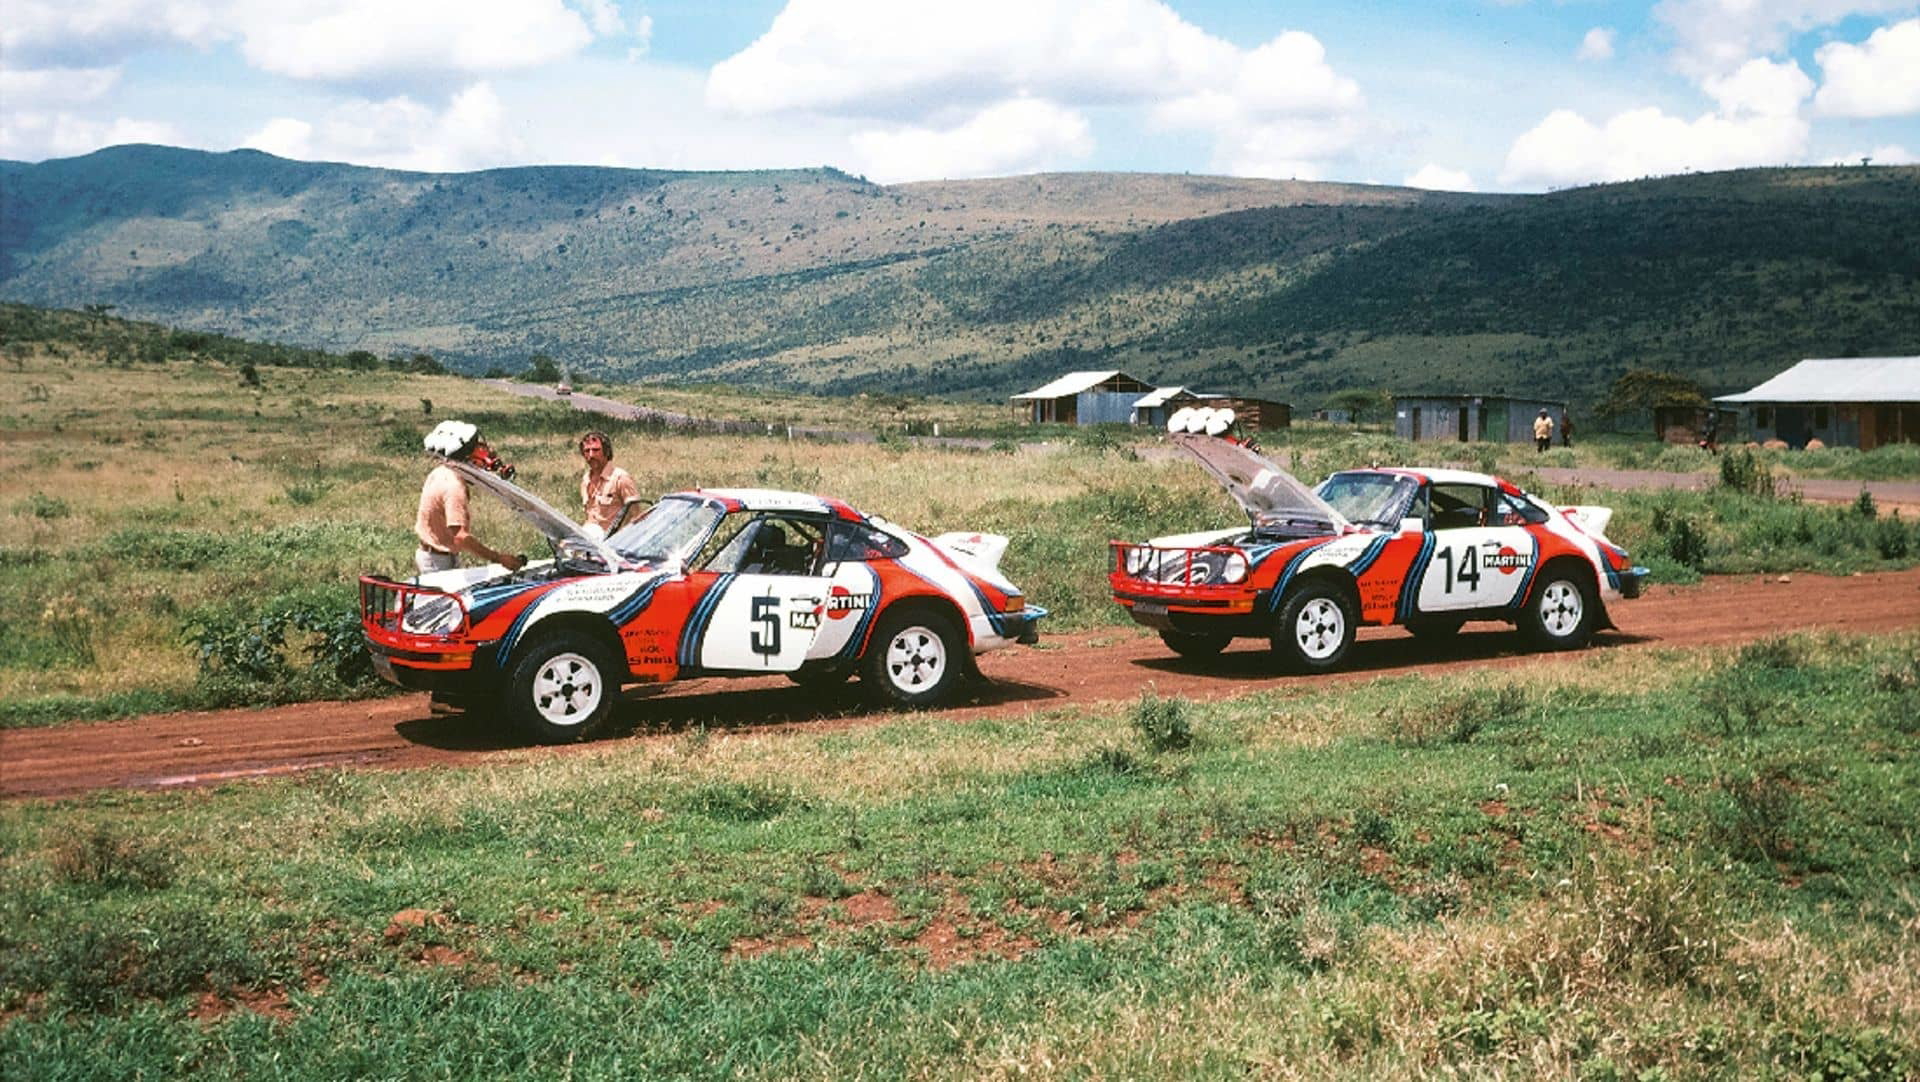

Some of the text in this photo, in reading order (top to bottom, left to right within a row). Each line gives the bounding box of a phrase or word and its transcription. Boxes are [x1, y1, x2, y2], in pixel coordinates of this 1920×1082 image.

[1437, 545, 1481, 594] 14
[1485, 555, 1532, 568] MARTINI
[750, 596, 782, 656] 5
